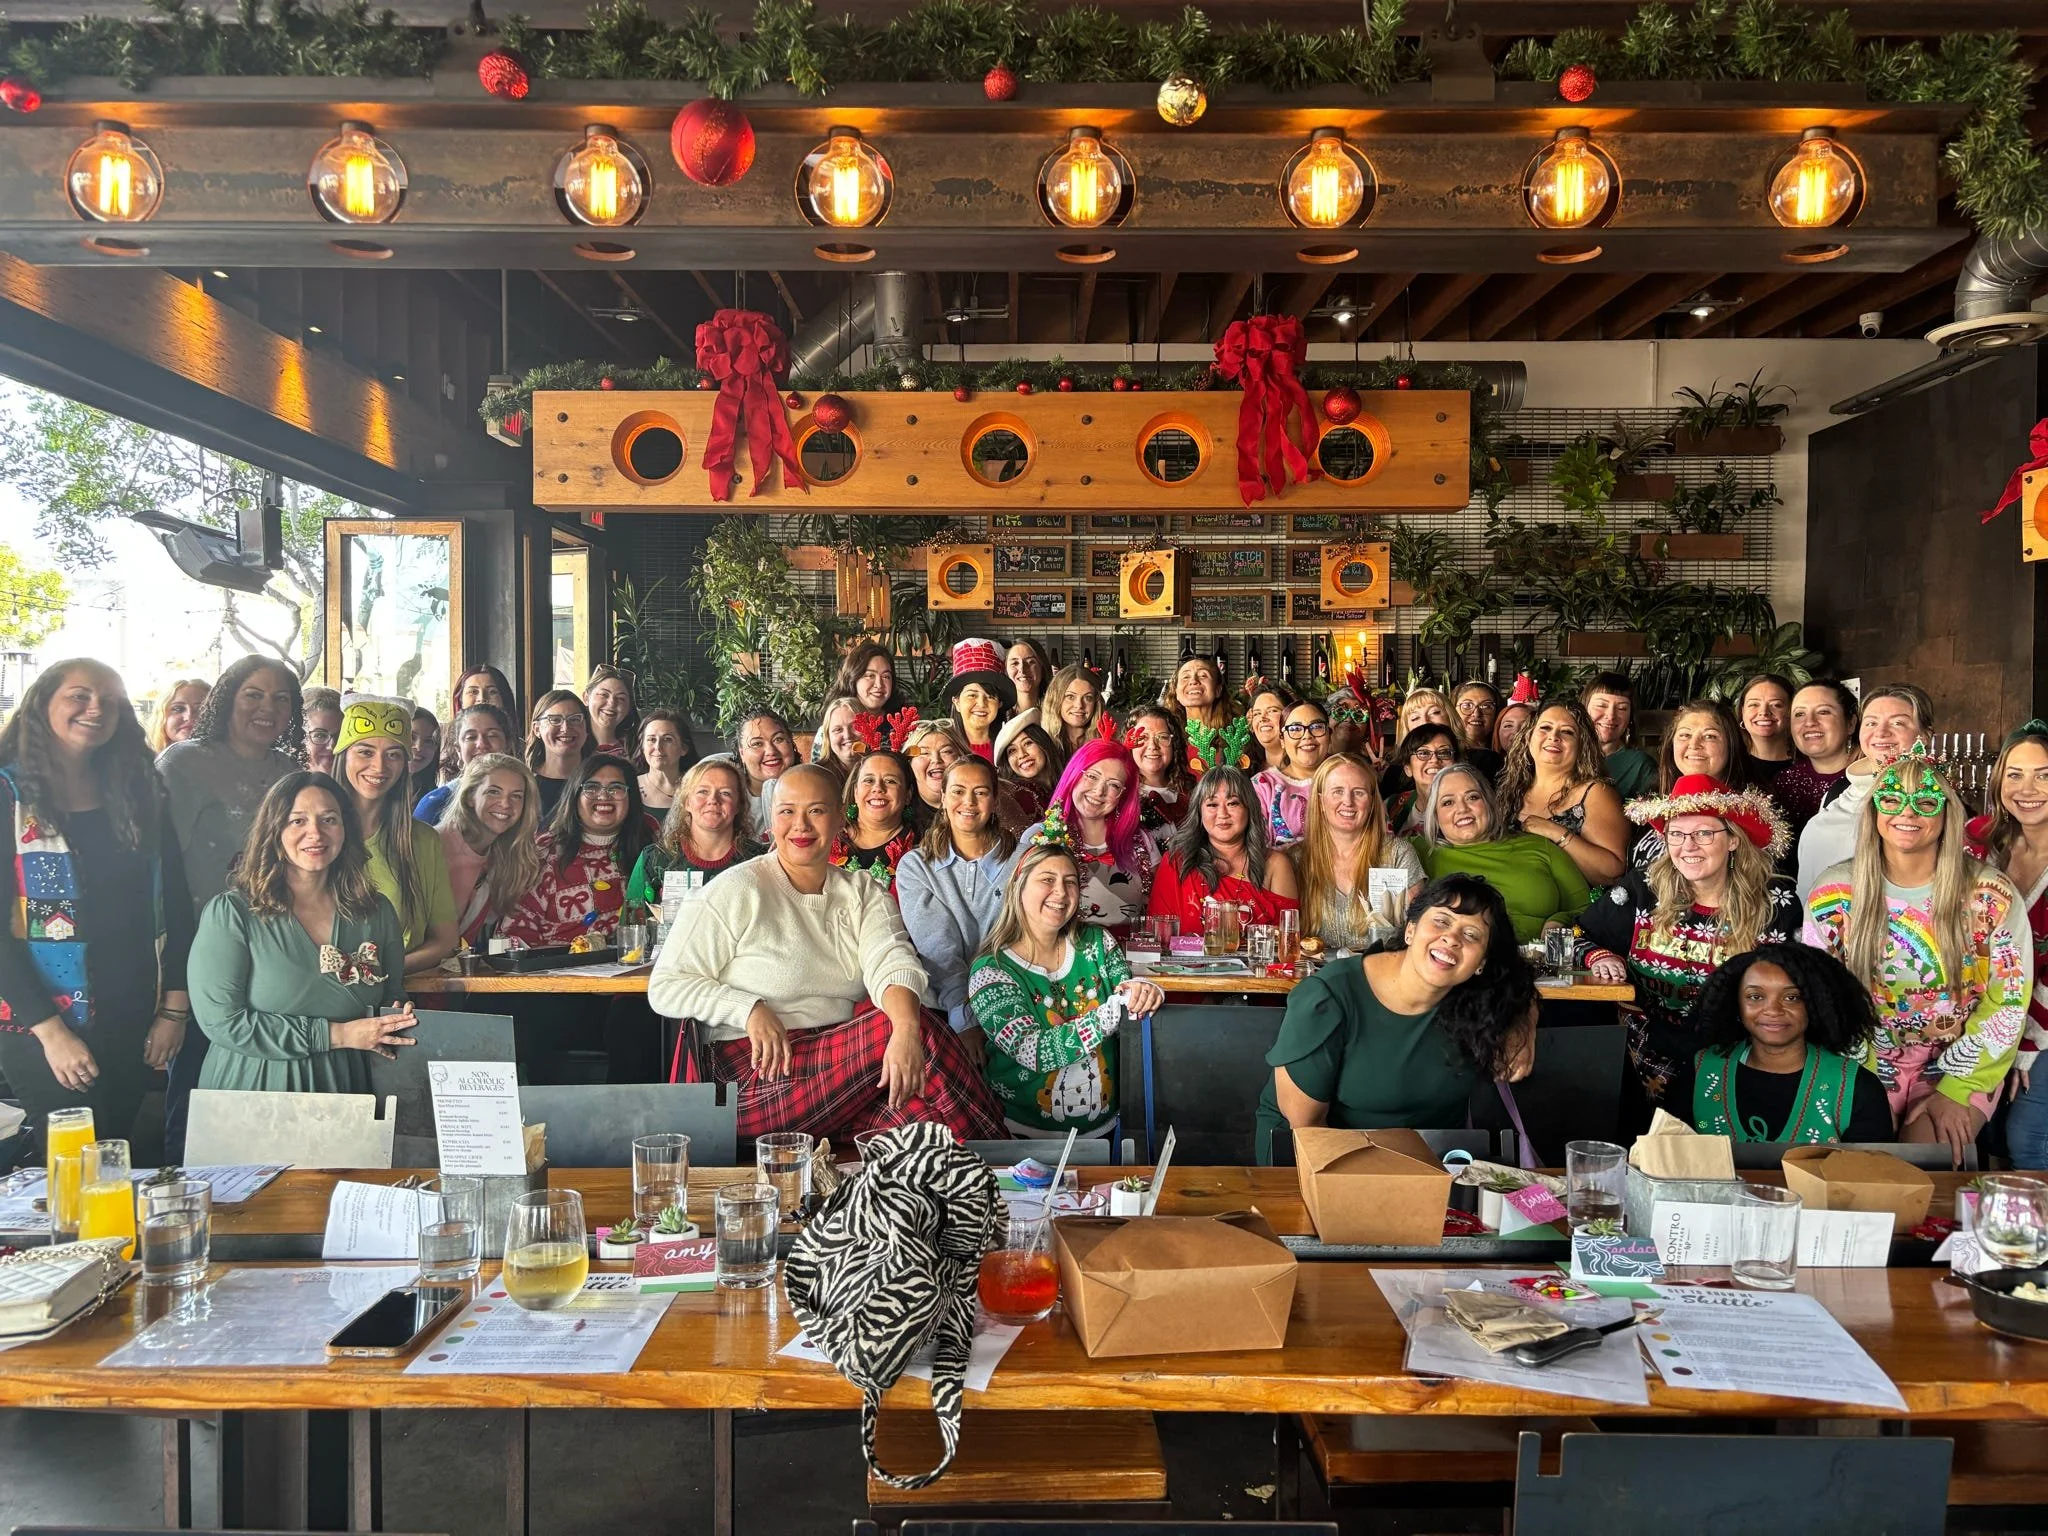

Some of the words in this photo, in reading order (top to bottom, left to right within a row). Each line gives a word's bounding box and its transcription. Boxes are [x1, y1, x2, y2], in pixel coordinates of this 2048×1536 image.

[1234, 552, 1262, 561] KETCH
[458, 1077, 505, 1086] ALCOHOLIC
[459, 1084, 505, 1092] BEVERAGES
[1520, 1190, 1554, 1209] torrey
[1666, 1212, 1681, 1265] CONTRO
[1702, 1232, 1710, 1260] DESSERT
[664, 1242, 717, 1260] amy
